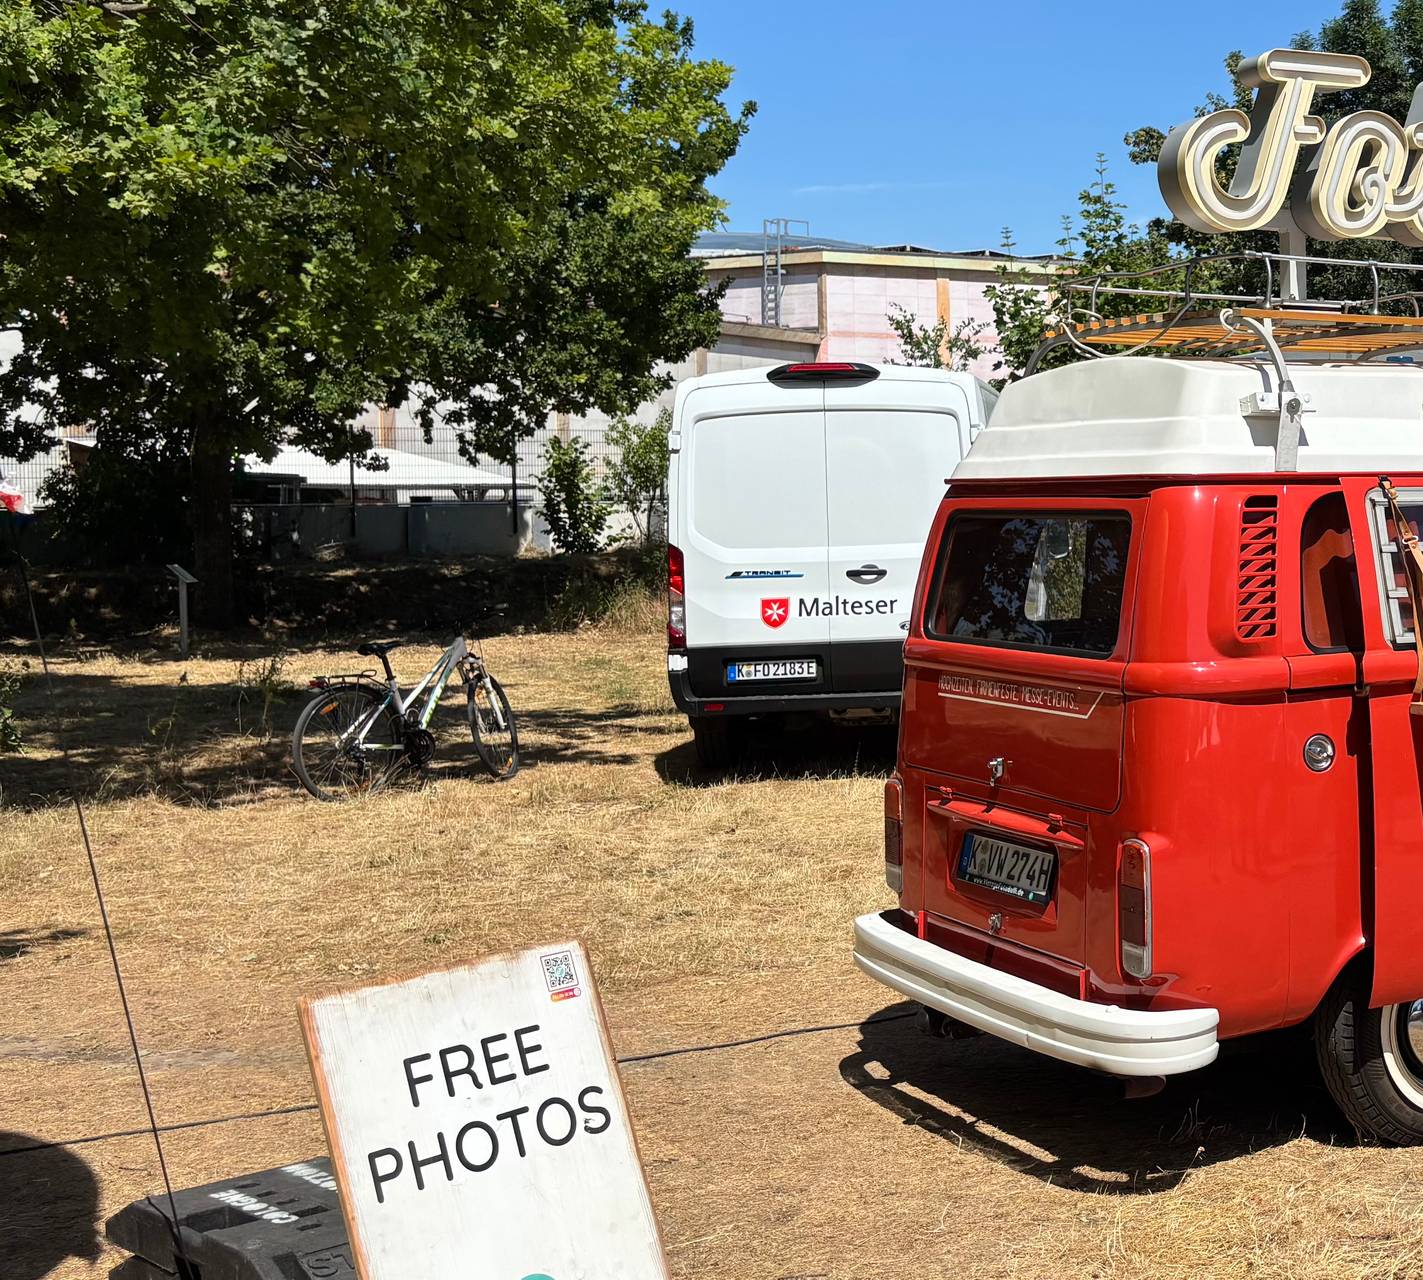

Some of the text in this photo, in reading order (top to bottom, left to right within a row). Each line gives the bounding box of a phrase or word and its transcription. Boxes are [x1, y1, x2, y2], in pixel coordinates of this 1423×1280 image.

[798, 595, 898, 617] Malteser
[403, 1024, 550, 1108] FREE
[367, 1085, 612, 1204] PHOTOS
